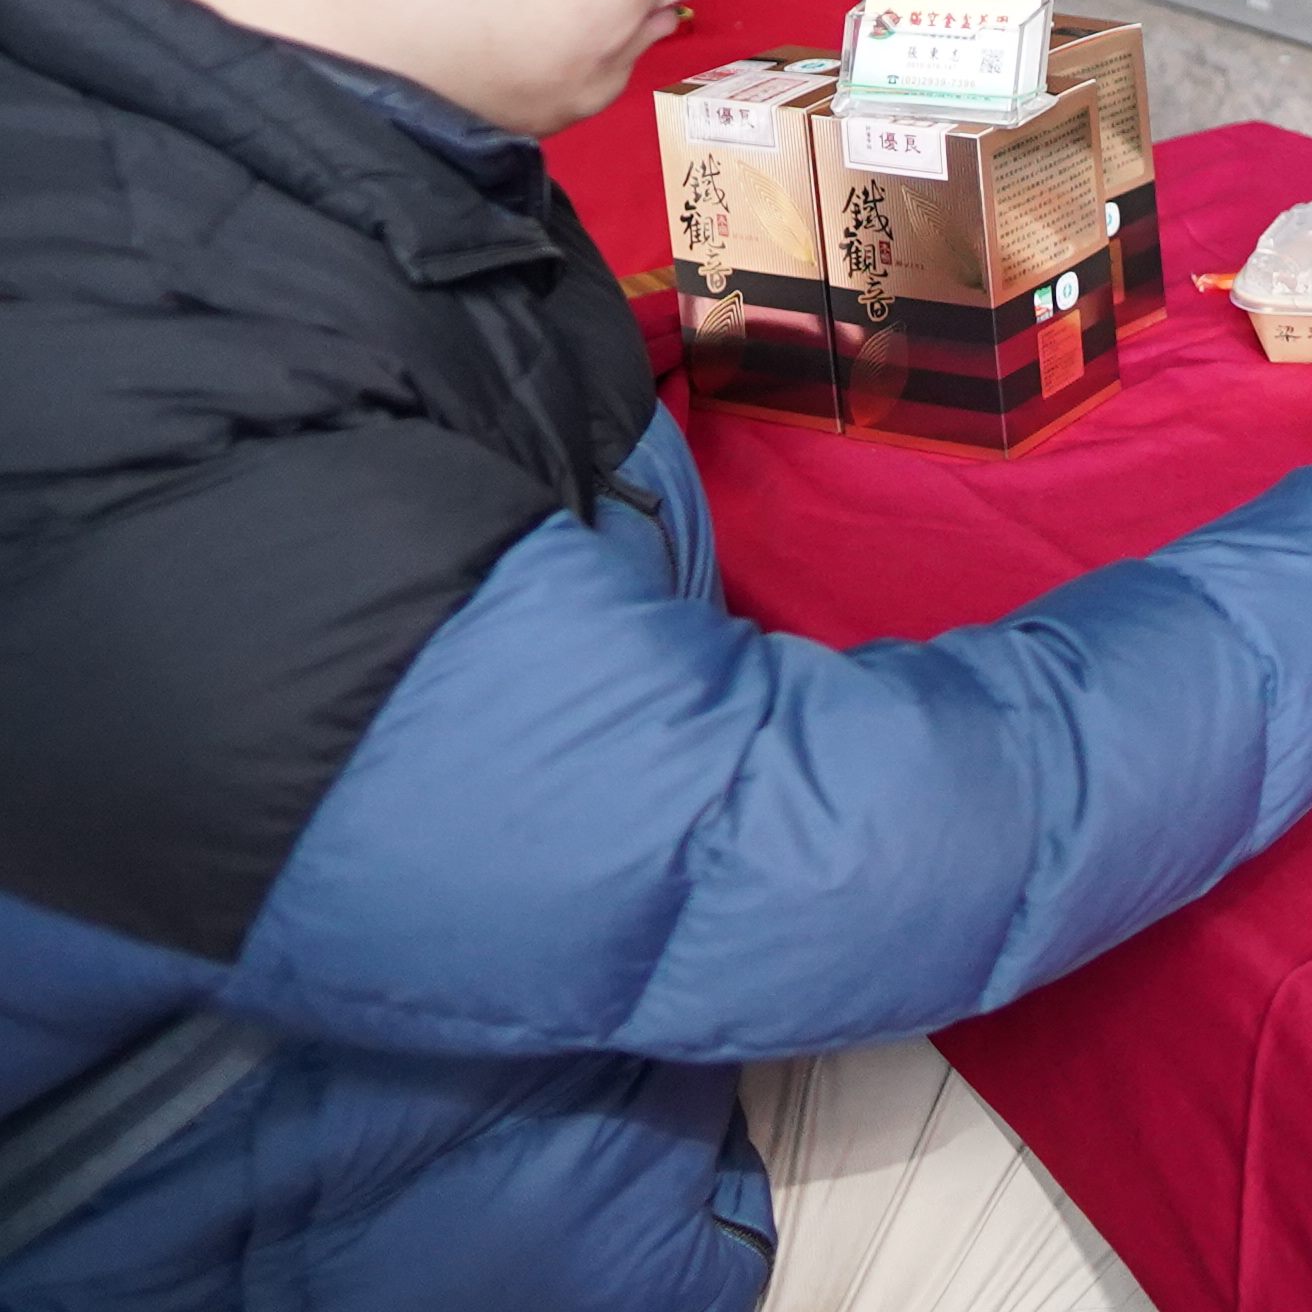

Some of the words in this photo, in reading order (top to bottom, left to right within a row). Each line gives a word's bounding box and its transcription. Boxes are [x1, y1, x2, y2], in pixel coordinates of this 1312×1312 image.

[717, 106, 754, 128] 優良
[879, 132, 921, 154] 優良
[680, 153, 732, 292] 鐵觀音
[839, 179, 894, 321] 鐵觀音
